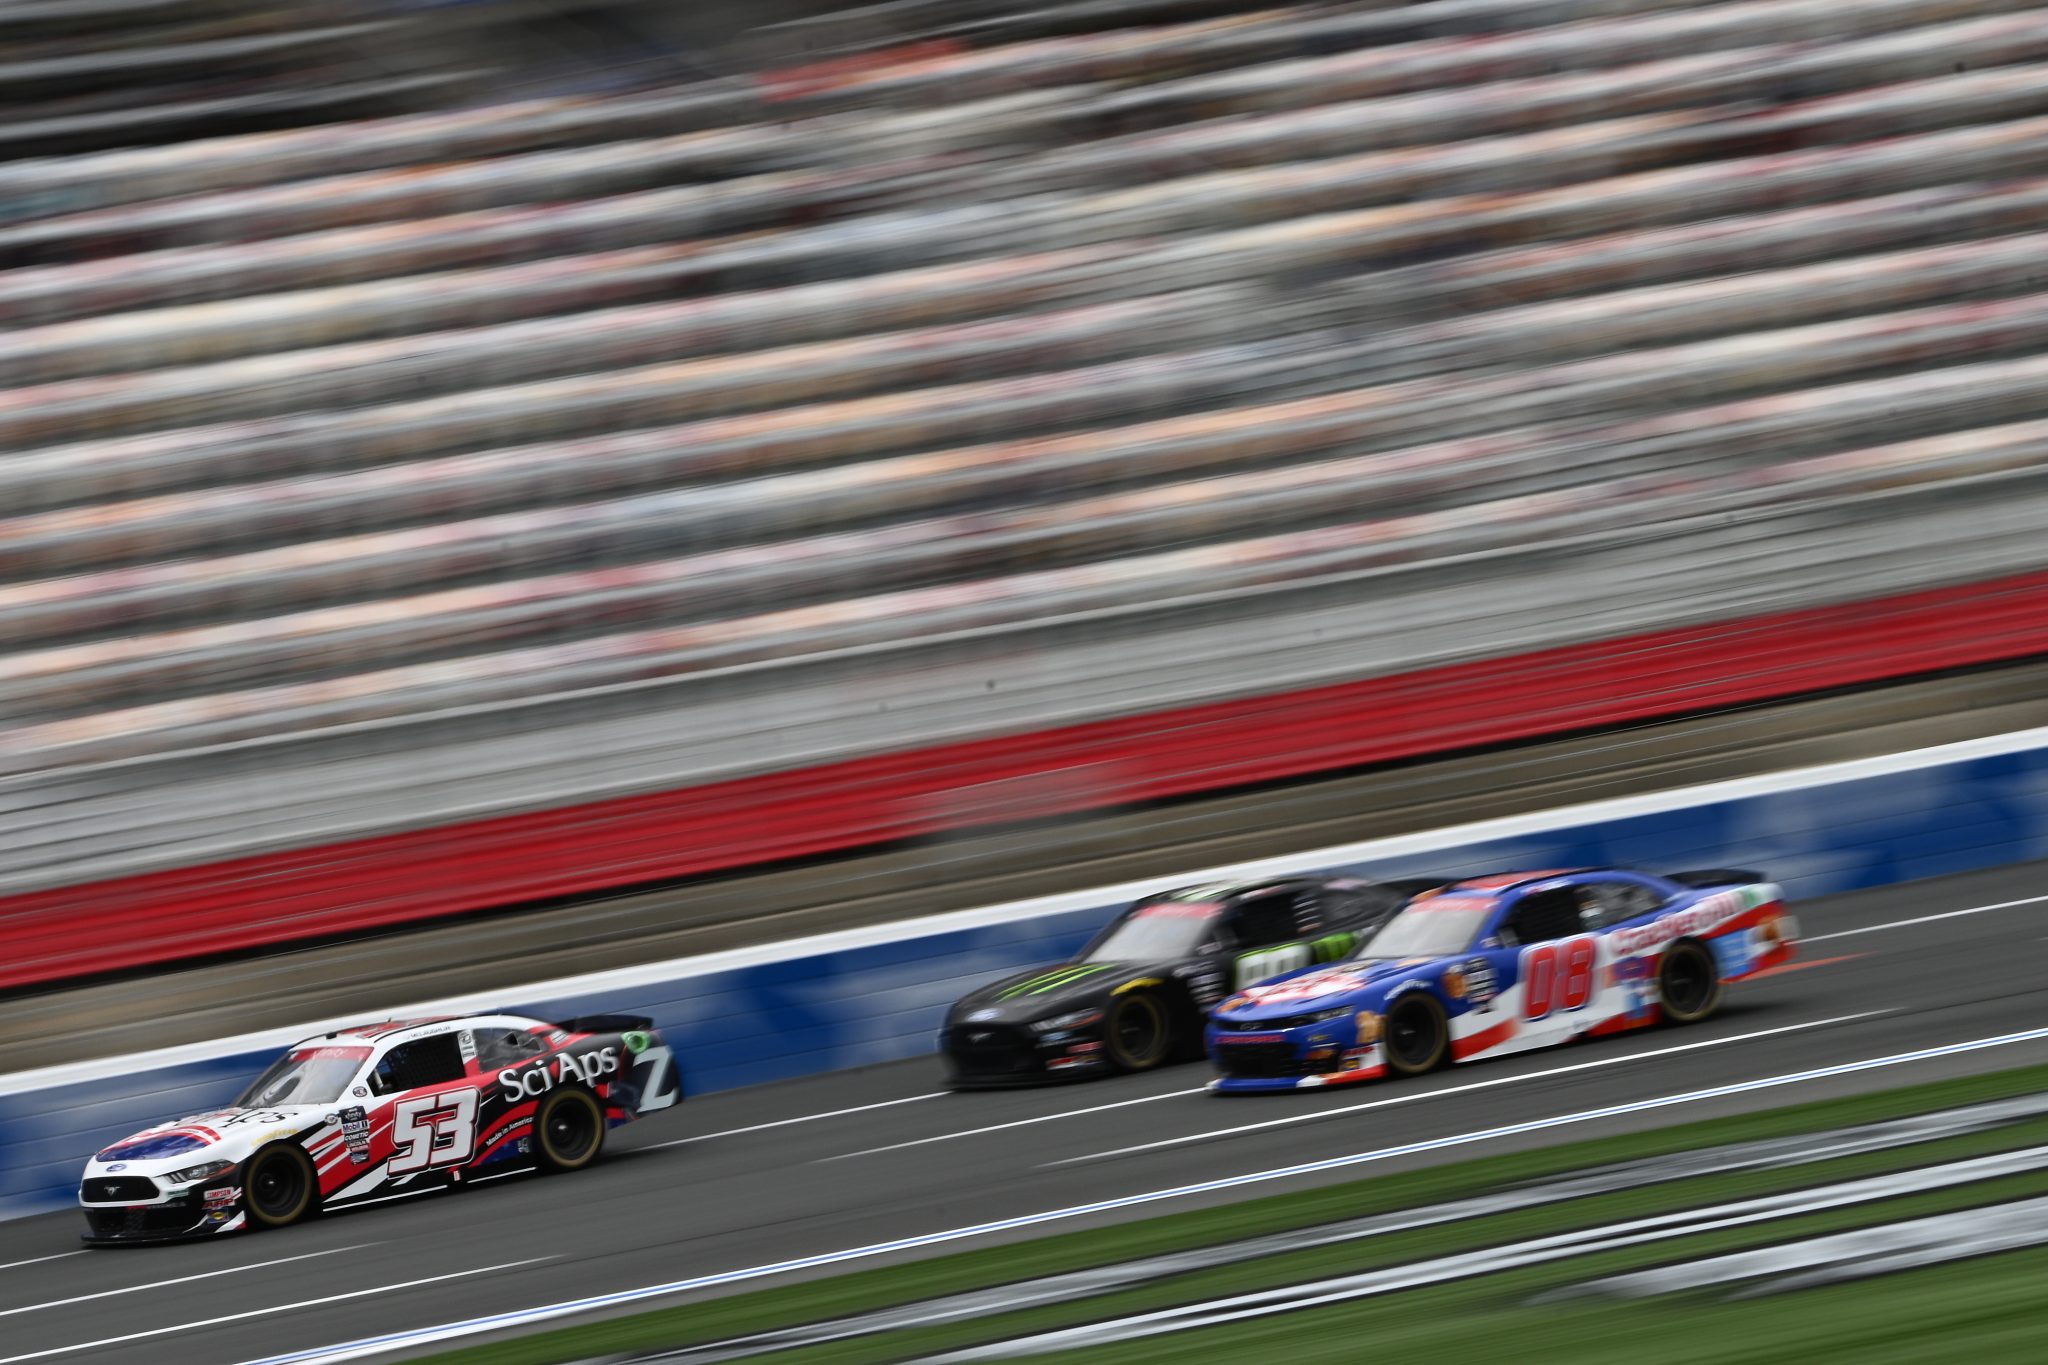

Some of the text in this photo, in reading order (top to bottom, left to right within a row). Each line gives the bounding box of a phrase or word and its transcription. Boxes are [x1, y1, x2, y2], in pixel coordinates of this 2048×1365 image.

[1524, 937, 1597, 1020] 08
[499, 1047, 619, 1103] Sci Aps
[342, 1121, 360, 1131] Mobil
[387, 1086, 480, 1178] 53
[485, 1132, 503, 1146] Made
[509, 1117, 534, 1130] America
